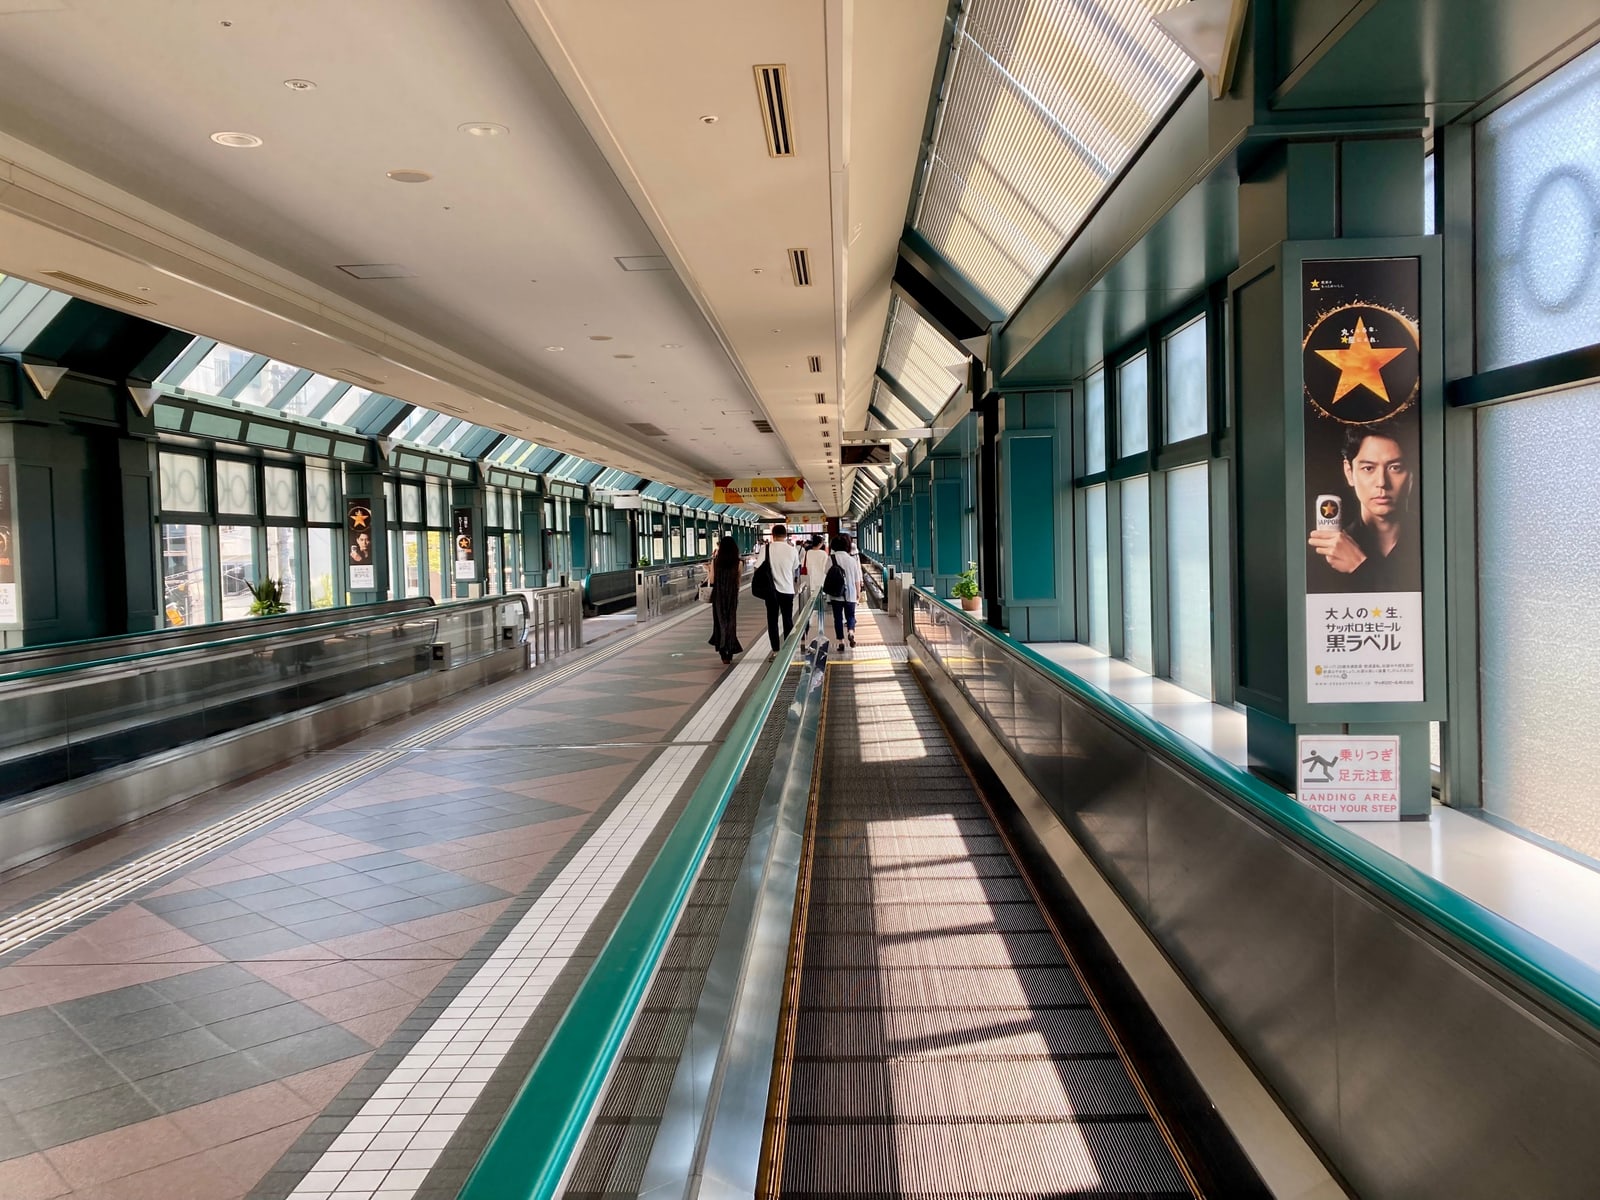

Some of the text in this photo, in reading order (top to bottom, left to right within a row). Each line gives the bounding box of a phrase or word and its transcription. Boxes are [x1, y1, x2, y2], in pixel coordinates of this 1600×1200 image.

[1326, 622, 1402, 633] サッポロ生ビール
[1326, 634, 1402, 653] 黒ラベル
[1339, 748, 1393, 762] 乗りつぎ
[1338, 769, 1393, 782] 足元注意
[1302, 793, 1397, 801] LANDING AREA
[1307, 804, 1397, 812] ATCH YOUR STEP
